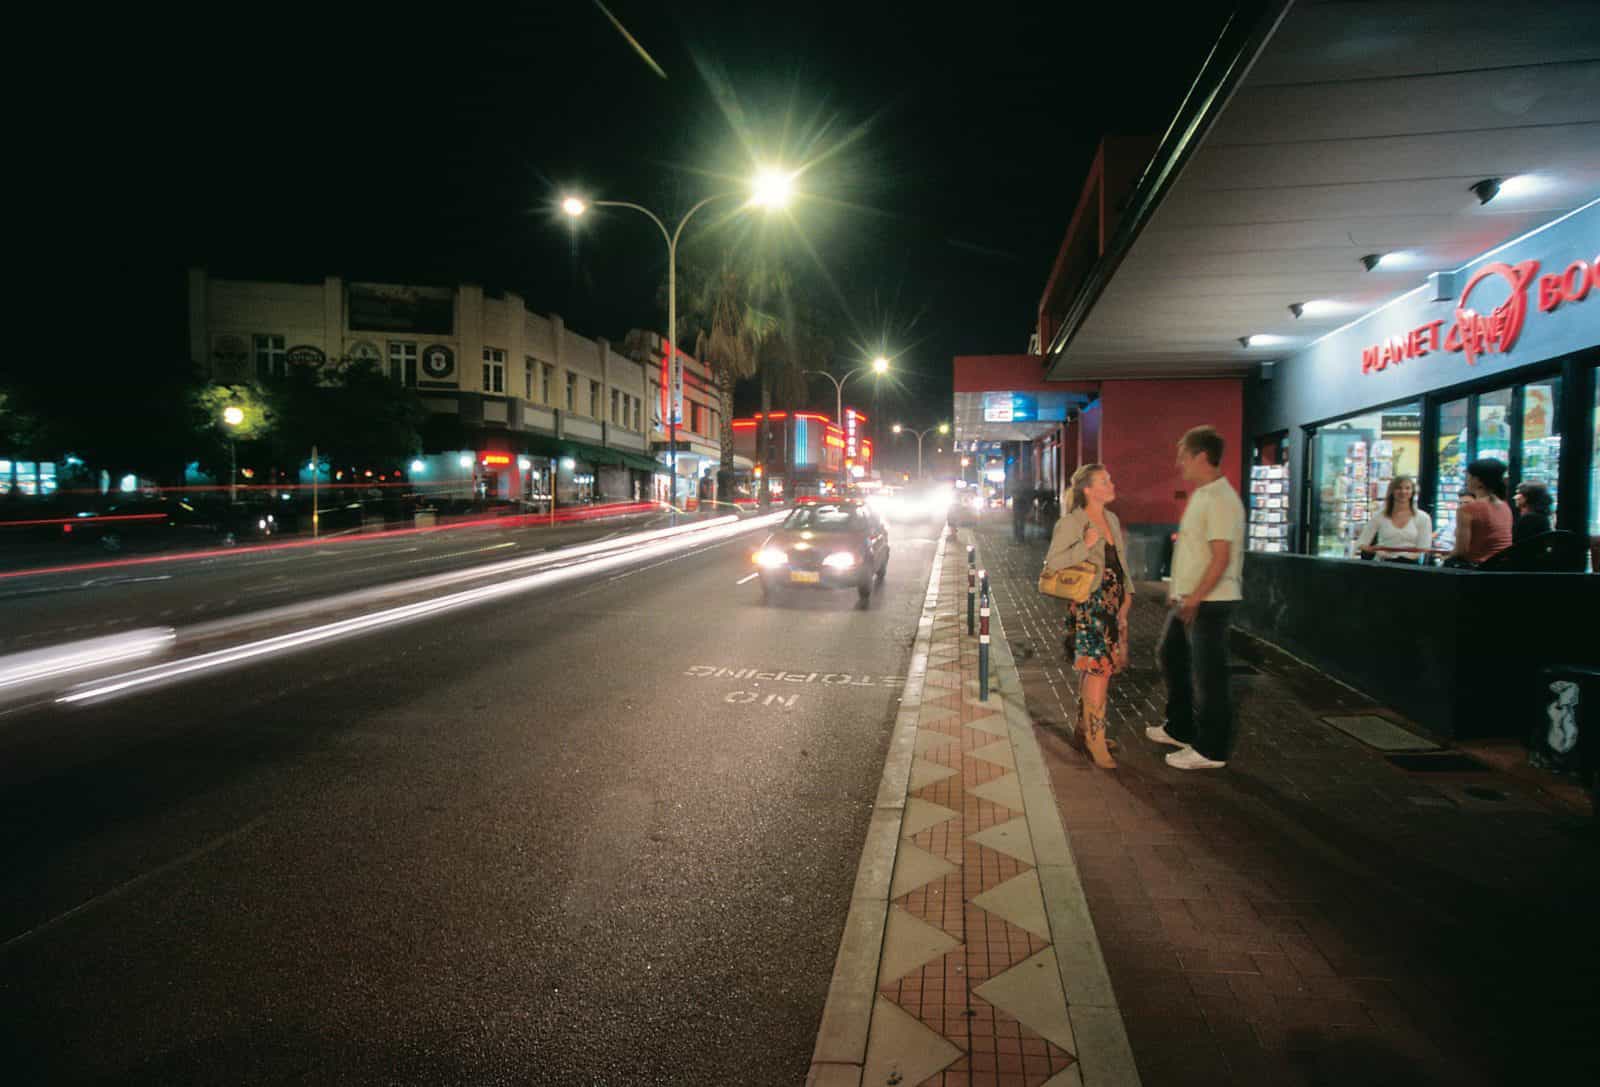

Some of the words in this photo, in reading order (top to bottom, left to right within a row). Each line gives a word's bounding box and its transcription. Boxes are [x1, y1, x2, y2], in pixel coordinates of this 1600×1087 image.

[1361, 319, 1446, 375] PLANET
[682, 665, 907, 688] STOPPING
[725, 691, 800, 707] NO
